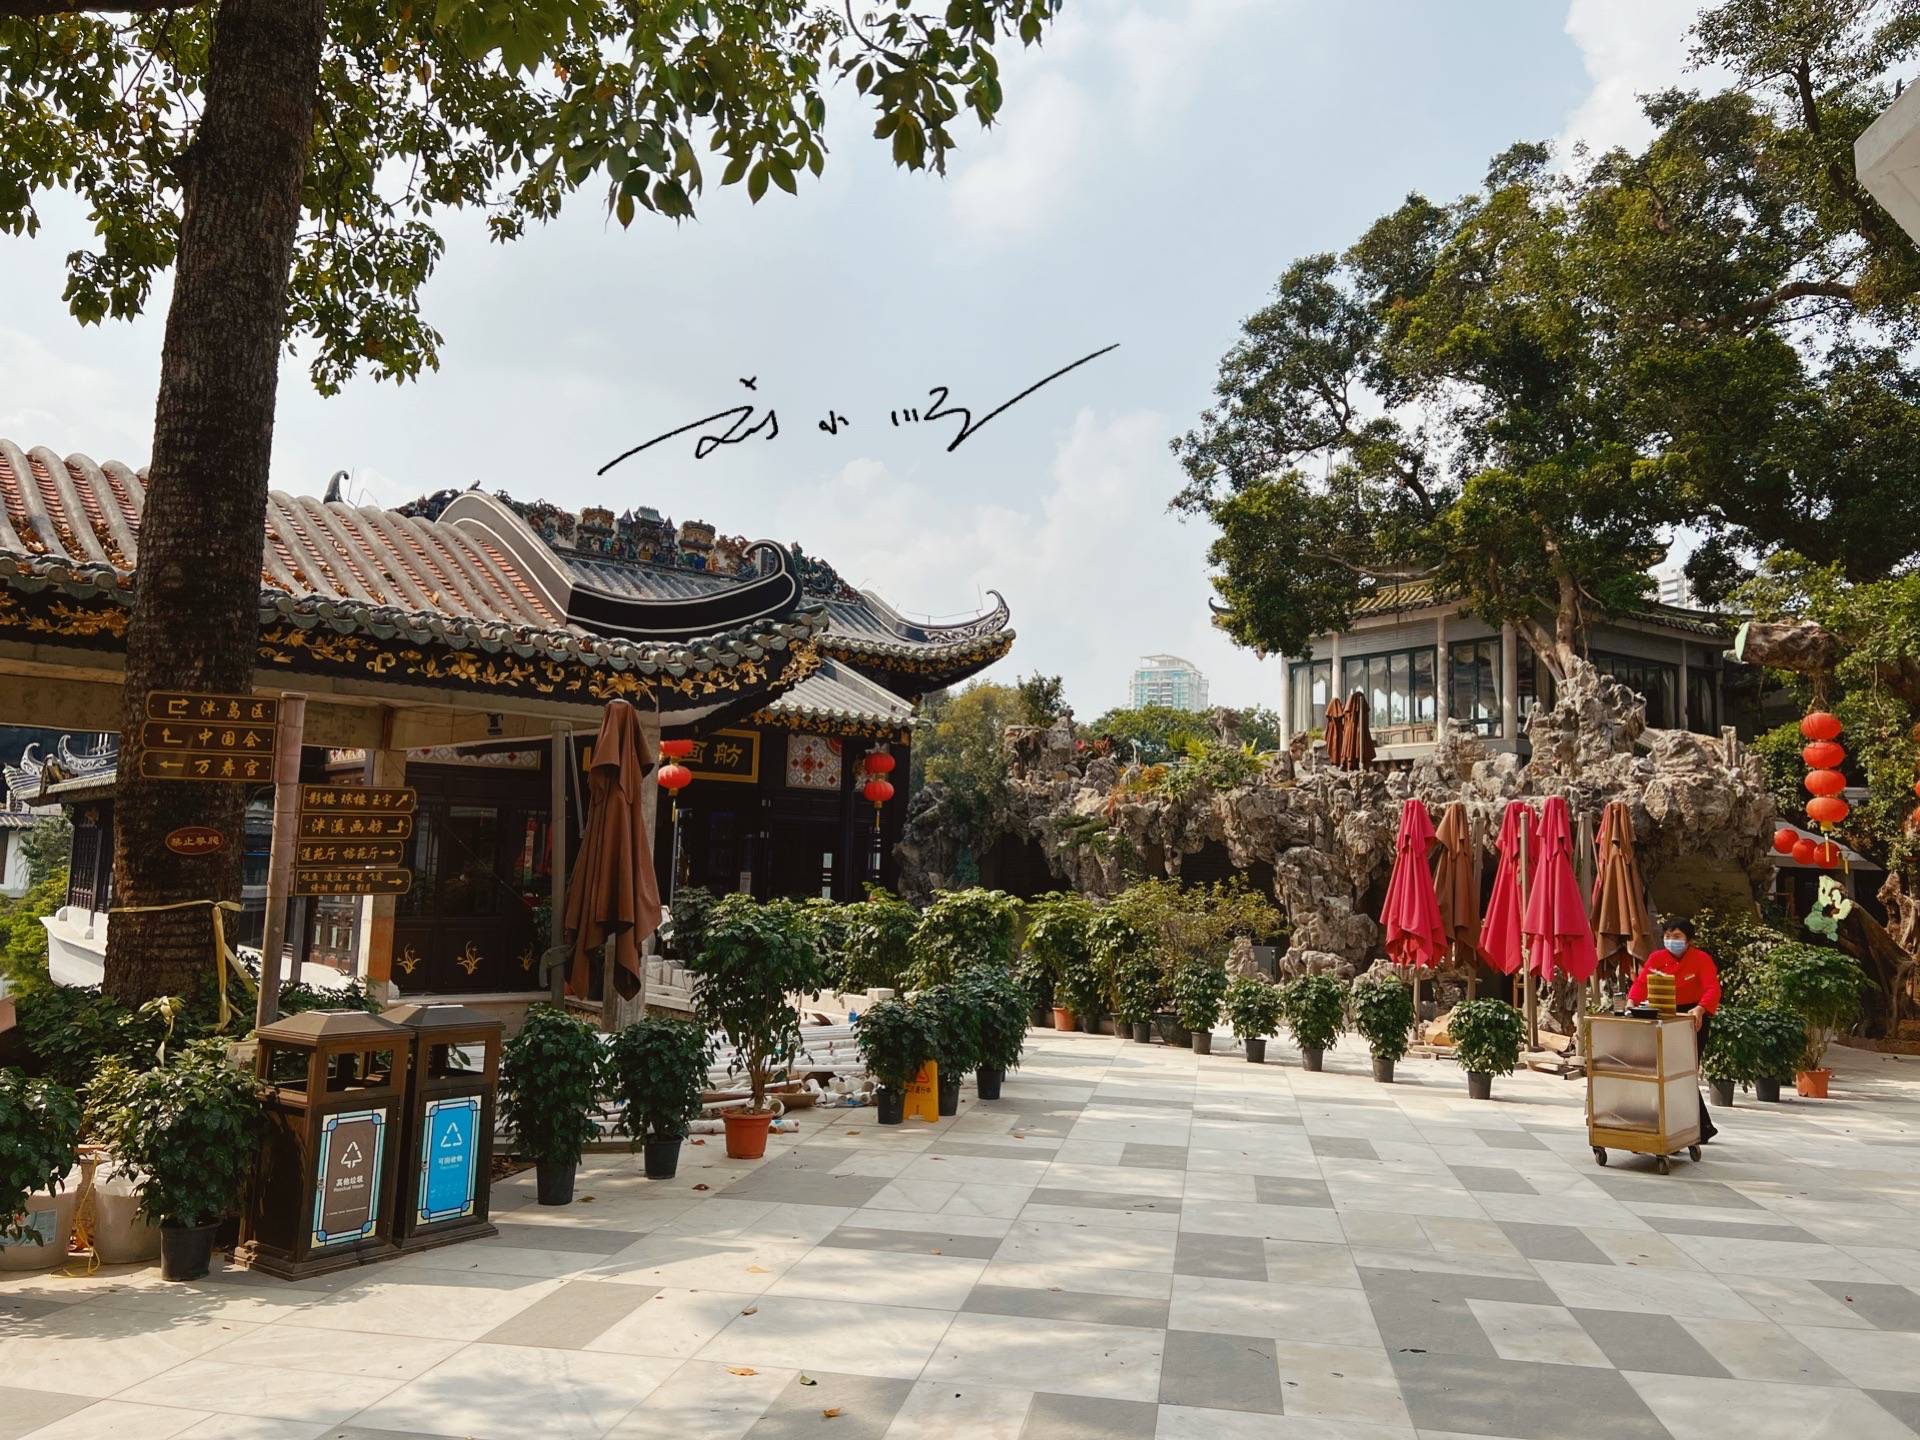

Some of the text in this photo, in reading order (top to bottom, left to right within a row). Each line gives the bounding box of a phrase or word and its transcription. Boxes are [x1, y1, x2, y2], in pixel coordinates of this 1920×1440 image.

[200, 700, 263, 719] 泮岛区
[198, 728, 260, 747] 中国会
[195, 758, 259, 776] 万寿宫
[335, 1175, 364, 1187] 其他垃圾
